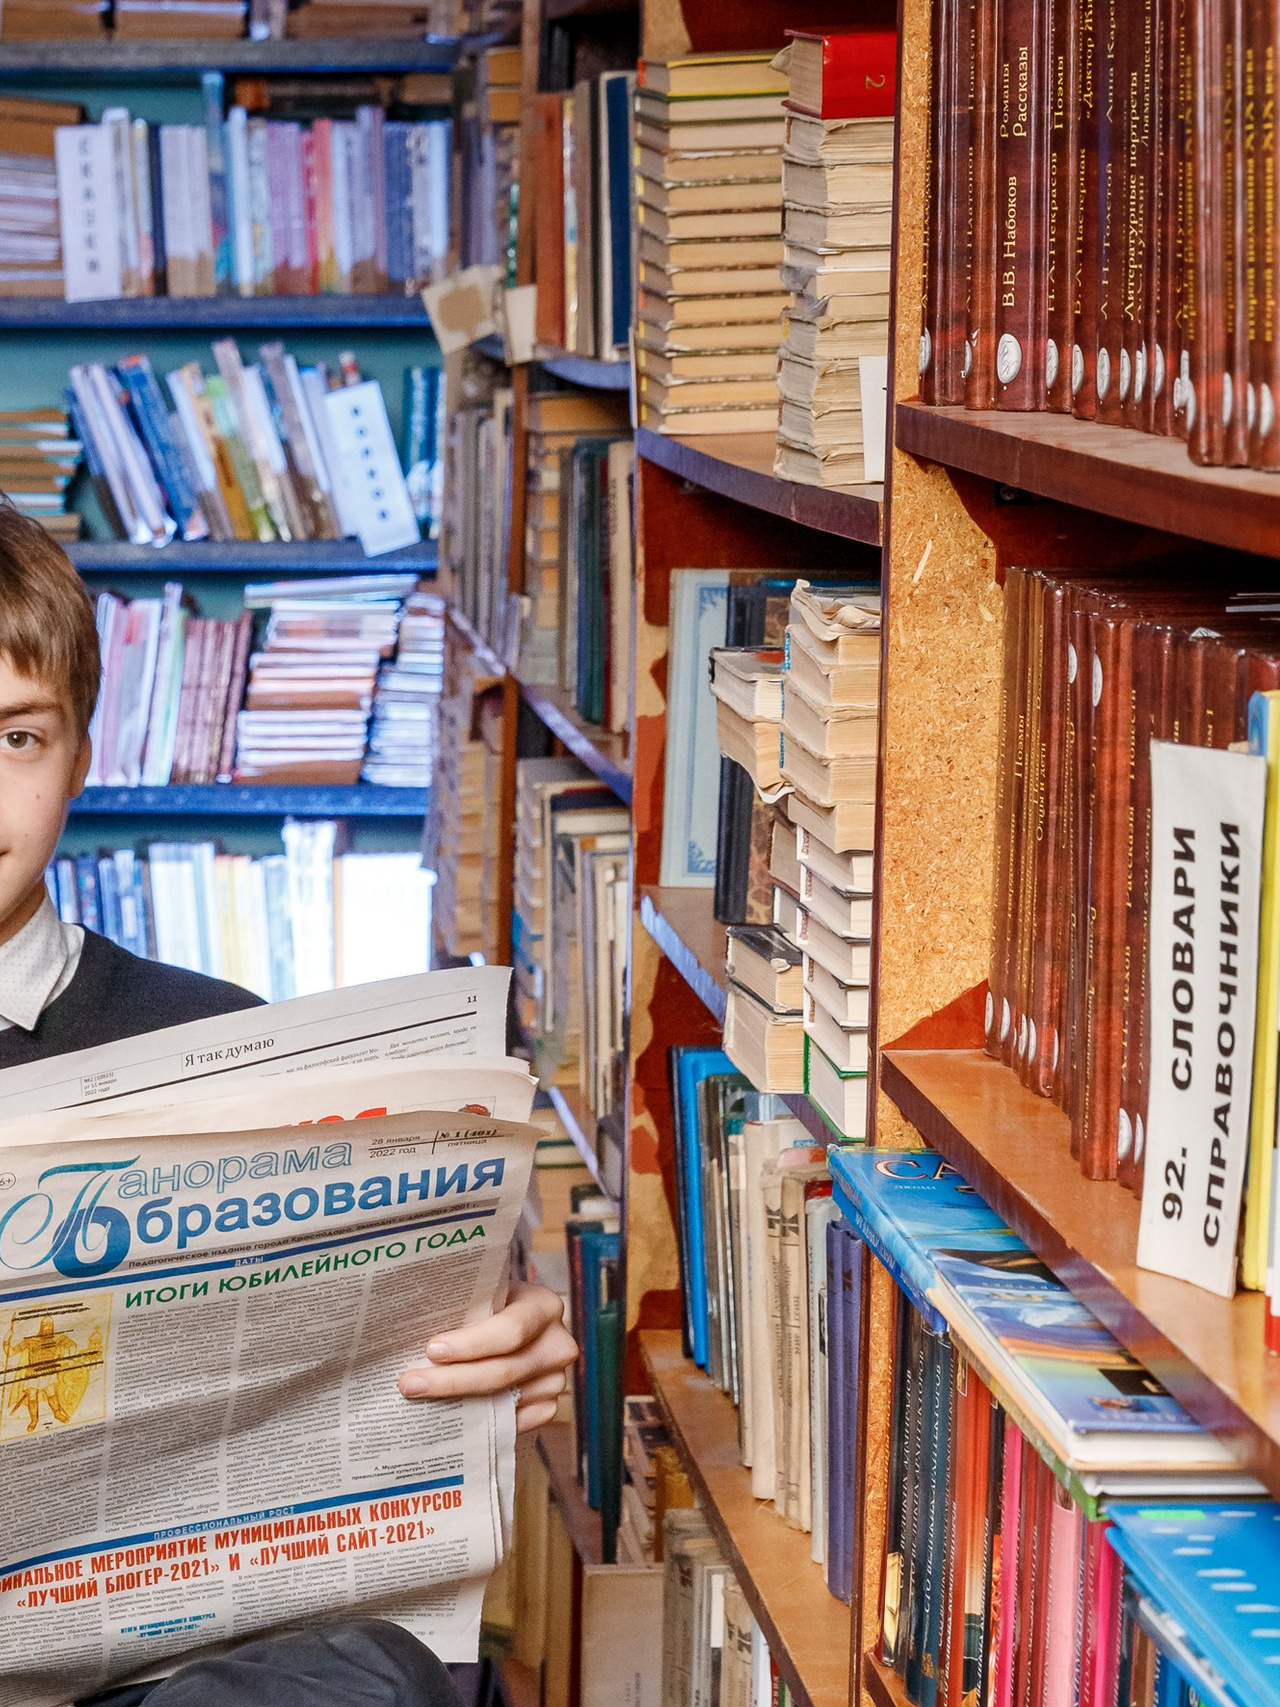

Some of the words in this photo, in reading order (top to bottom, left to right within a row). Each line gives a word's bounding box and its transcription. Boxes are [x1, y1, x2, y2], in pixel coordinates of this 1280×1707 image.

[999, 62, 1010, 138] Романы
[1011, 45, 1029, 137] Рассказы
[1053, 55, 1064, 129] Поэмы
[1082, 37, 1095, 119] «Доктор
[1105, 67, 1114, 123] Анна
[1127, 71, 1141, 168] портреты
[1003, 175, 1018, 259] Набоков
[1047, 152, 1059, 255] Некрасов
[1076, 148, 1087, 254] Пастернак
[1102, 162, 1113, 254] Толстой
[1002, 266, 1016, 308] В.В.
[1124, 174, 1138, 321] Литературные
[1014, 713, 1025, 779] Поэмы
[1127, 688, 1137, 782] Повести
[1036, 794, 1046, 842] Отцы
[1125, 805, 1135, 909] Рассказы
[466, 996, 478, 1004] 11
[1170, 826, 1196, 1092] СЛОВАРИ
[184, 1054, 195, 1067] Я
[197, 1049, 223, 1063] так
[224, 1038, 275, 1060] думаю
[1202, 821, 1241, 1249] СПРАВОЧНИКИ
[369, 1147, 395, 1159] 2022
[398, 1146, 417, 1157] год
[446, 1138, 487, 1148] пятница
[371, 1137, 385, 1146] 28
[386, 1134, 421, 1146] января
[52, 1157, 506, 1278] Образования
[1161, 1146, 1188, 1222] 92.
[125, 1280, 210, 1309] ИТОГИ
[218, 1241, 407, 1295] ЮБИЛЕЙНОГО
[414, 1223, 487, 1254] ГОДА
[127, 1251, 209, 1268] Педагогическое
[210, 1245, 252, 1256] издание
[253, 1239, 289, 1252] города
[234, 1255, 265, 1267] ДАТЫ
[903, 1368, 912, 1469] АДМИРАЛОВ
[915, 1350, 924, 1476] АРХИТЕКТОРОВ
[930, 1364, 941, 1495] АРХИТЕКТОРОВ
[17, 1577, 99, 1609] «ЛУЧШИЙ
[105, 1558, 220, 1594] БЛОГЕР-2021»
[228, 1552, 241, 1572] И
[249, 1534, 330, 1567] «ЛУЧШИЙ
[336, 1519, 436, 1553] САЙТ-2021»
[90, 1536, 208, 1575] МЕРОПРИЯТИЕ
[214, 1506, 363, 1550] МУНИЦИПАЛЬНЫХ
[368, 1489, 463, 1523] КОНКУРСОВ
[153, 1509, 265, 1541] ПРОФЕССИОНАЛЬНЫЙ
[268, 1505, 295, 1518] РОСТ
[926, 1496, 935, 1575] ВЕЛИКИХ
